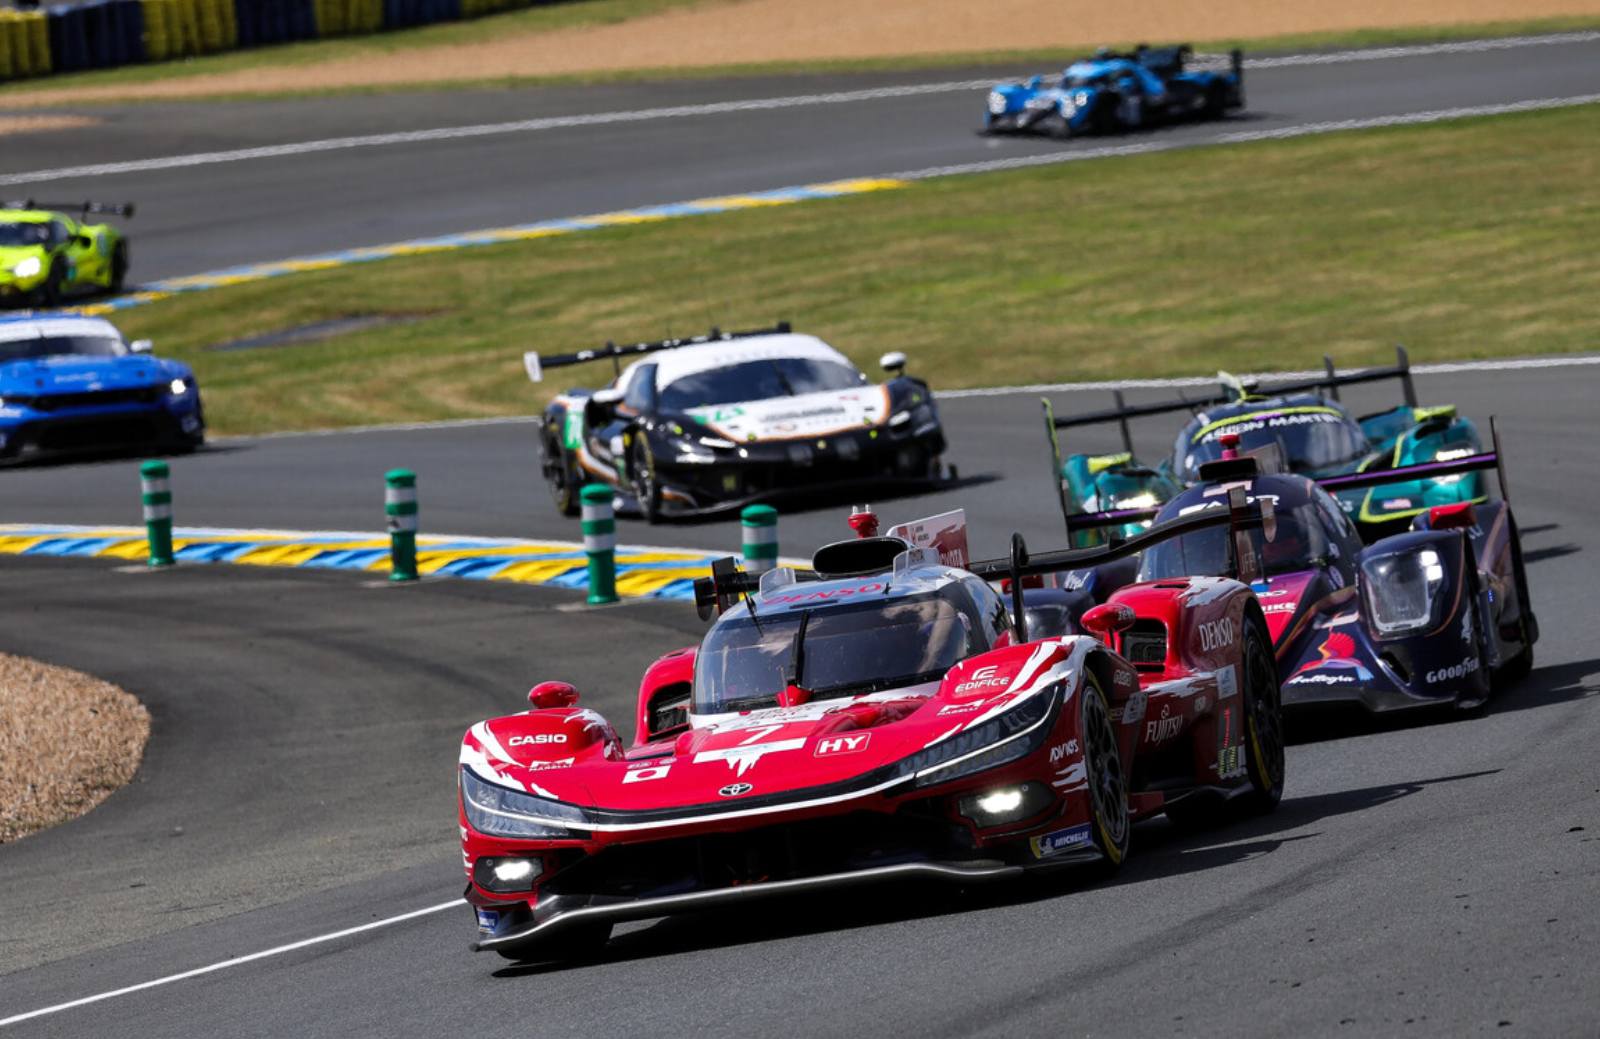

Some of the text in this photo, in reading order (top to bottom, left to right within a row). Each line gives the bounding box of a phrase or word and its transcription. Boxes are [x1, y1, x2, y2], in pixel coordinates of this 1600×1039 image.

[1198, 616, 1233, 652] DENSO
[954, 676, 1011, 694] EDIFICE
[1144, 714, 1184, 746] FUJITSU
[508, 734, 567, 747] CASIO
[818, 735, 866, 754] HY
